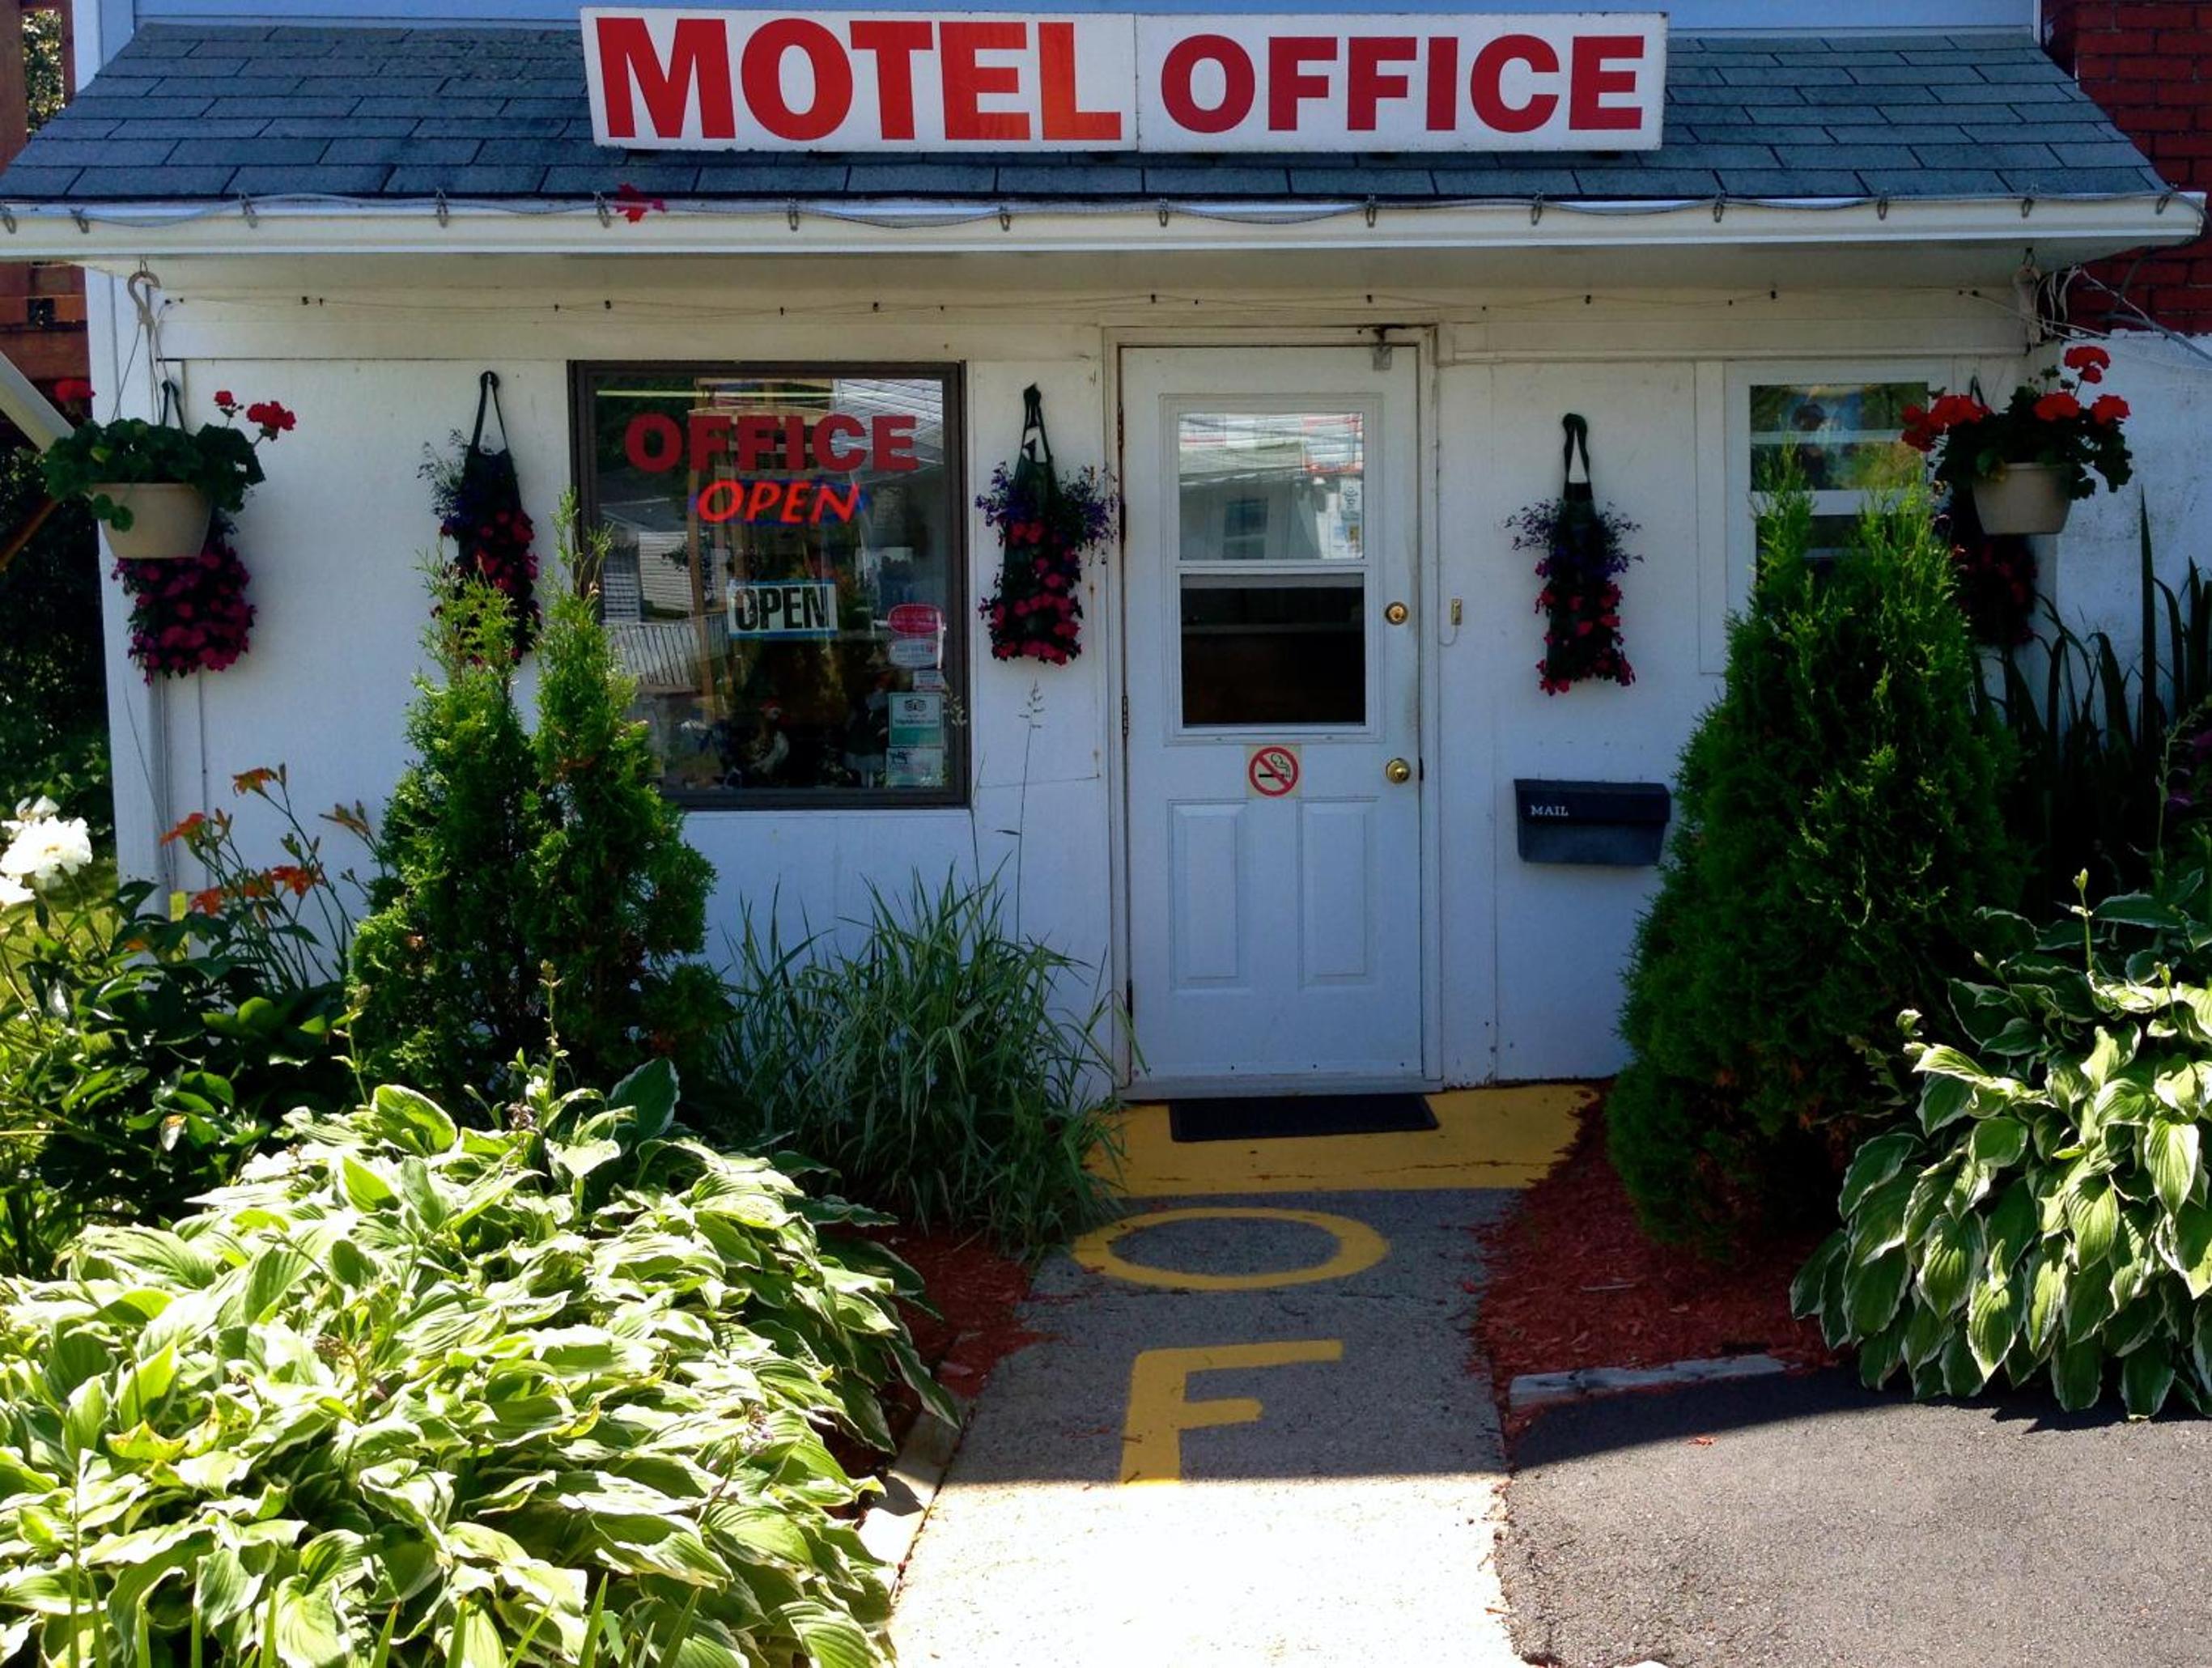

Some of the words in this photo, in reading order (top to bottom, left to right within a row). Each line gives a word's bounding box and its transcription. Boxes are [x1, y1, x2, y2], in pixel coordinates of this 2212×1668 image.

[596, 17, 1122, 141] MOTEL
[1161, 33, 1644, 133] OFFICE
[625, 413, 919, 473] OFFICE
[696, 479, 860, 524] OPEN
[735, 586, 829, 631] OPEN
[1531, 804, 1569, 817] MAIL
